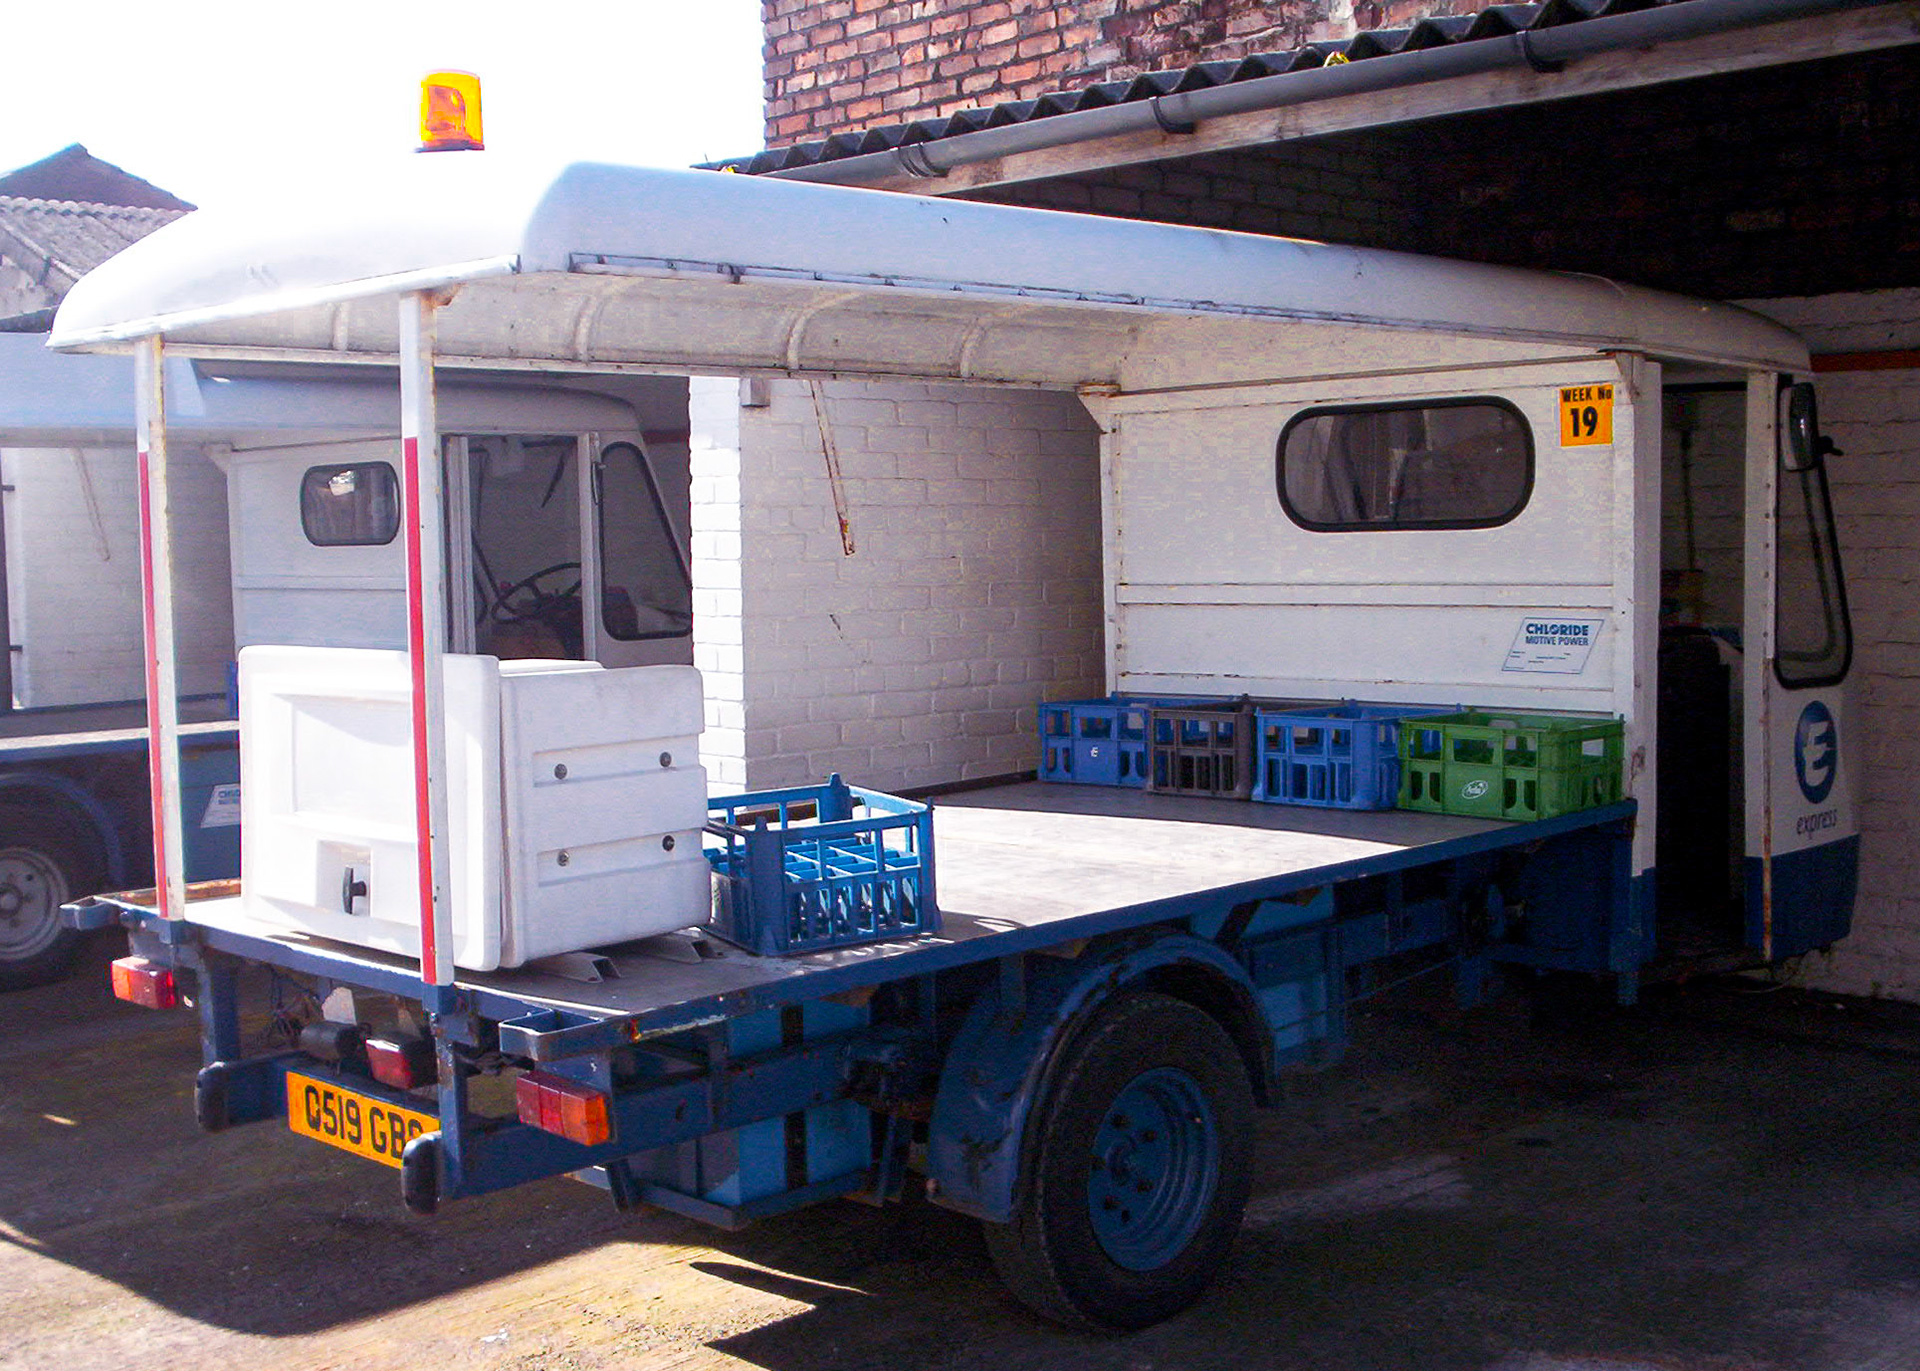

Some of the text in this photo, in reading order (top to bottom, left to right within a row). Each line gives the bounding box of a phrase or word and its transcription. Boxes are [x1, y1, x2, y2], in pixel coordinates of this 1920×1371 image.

[1561, 387, 1592, 402] WEEK
[1570, 406, 1598, 437] 19
[1526, 623, 1589, 636] CHLORIDE
[1525, 636, 1589, 646] MOTIVE POWER
[1796, 808, 1837, 839] express
